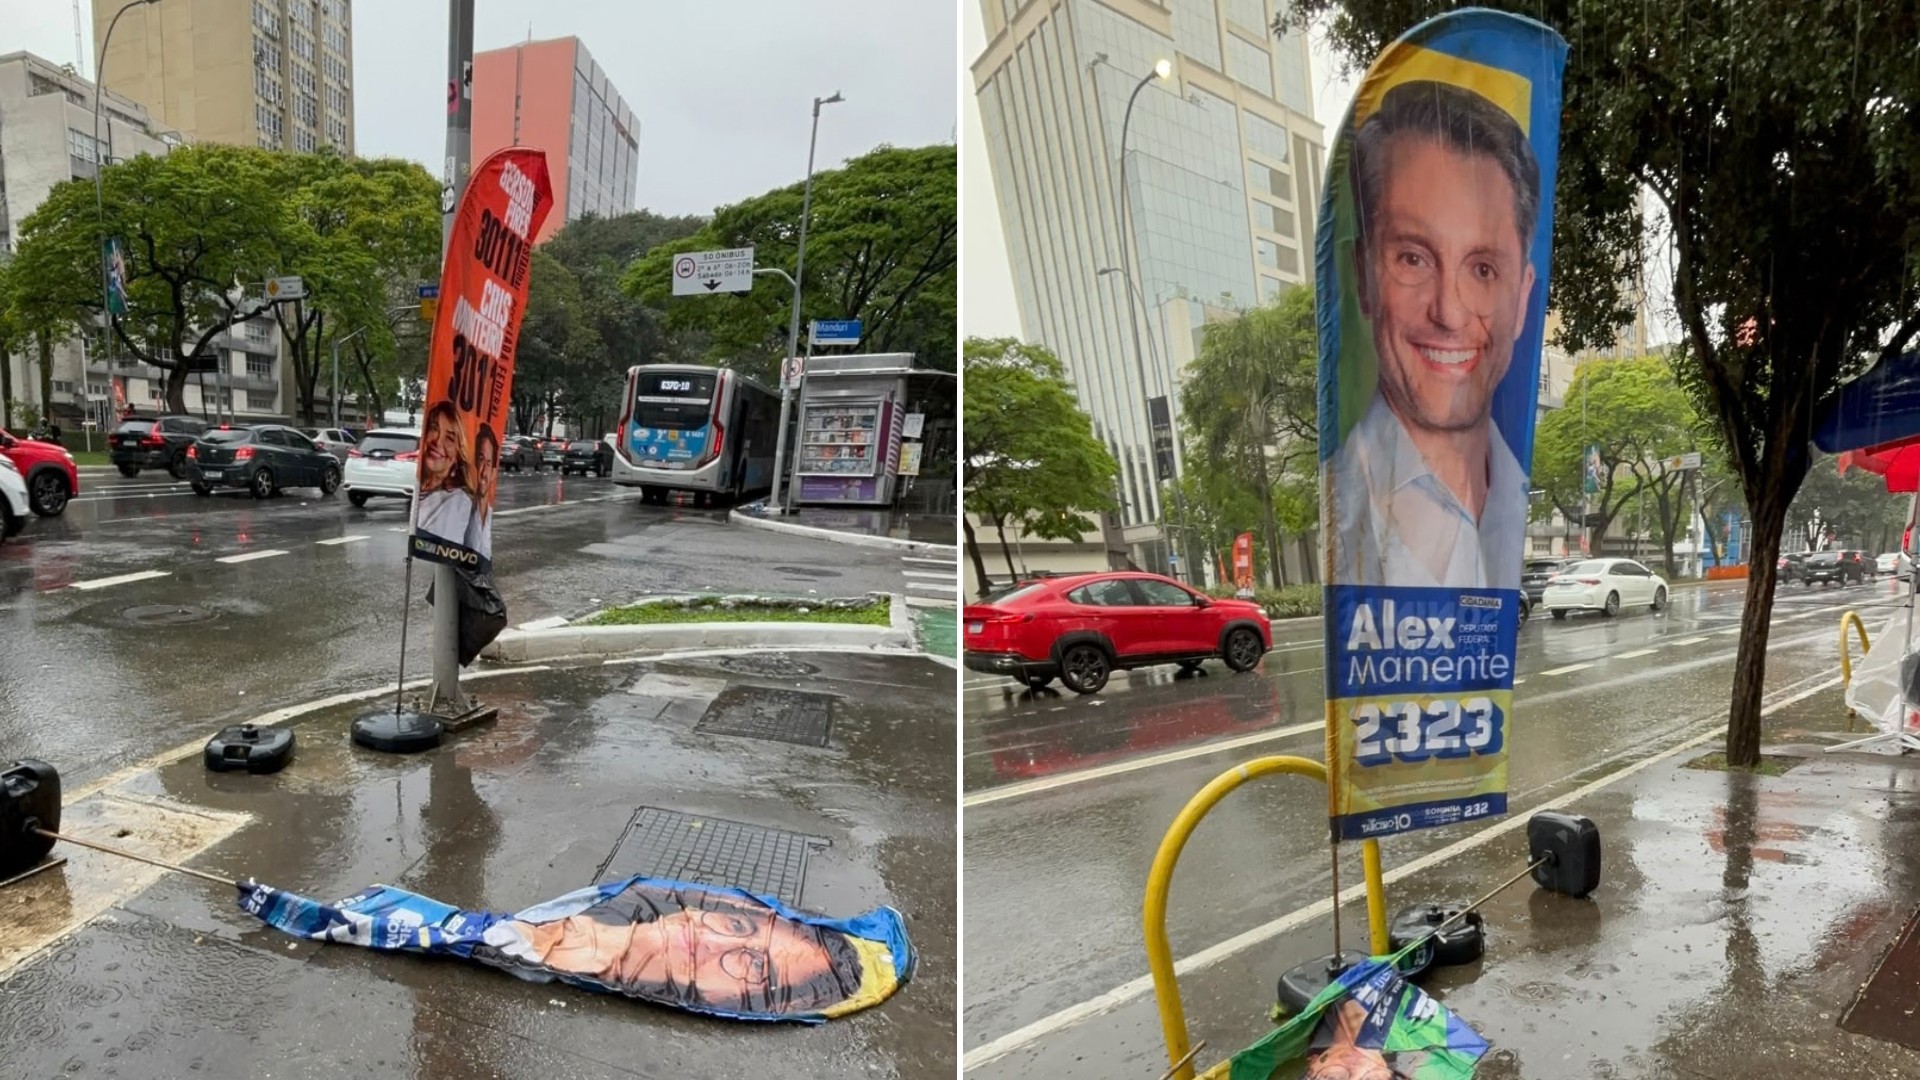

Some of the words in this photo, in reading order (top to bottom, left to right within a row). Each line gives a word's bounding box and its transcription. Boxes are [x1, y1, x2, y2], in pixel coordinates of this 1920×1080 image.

[504, 198, 531, 240] PIRES
[475, 208, 523, 287] 30111
[480, 278, 512, 329] CRIS
[817, 322, 848, 332] Manduri
[448, 333, 497, 423] 3011
[494, 364, 507, 418] FEDERAL
[1461, 597, 1500, 608] CIDADANIA
[1347, 599, 1457, 650] Alex
[1458, 635, 1491, 644] FEDERAL
[1459, 624, 1497, 633] DEPUTADO
[1347, 648, 1510, 685] Manente
[1353, 697, 1494, 758] 2323
[1464, 802, 1489, 817] 232
